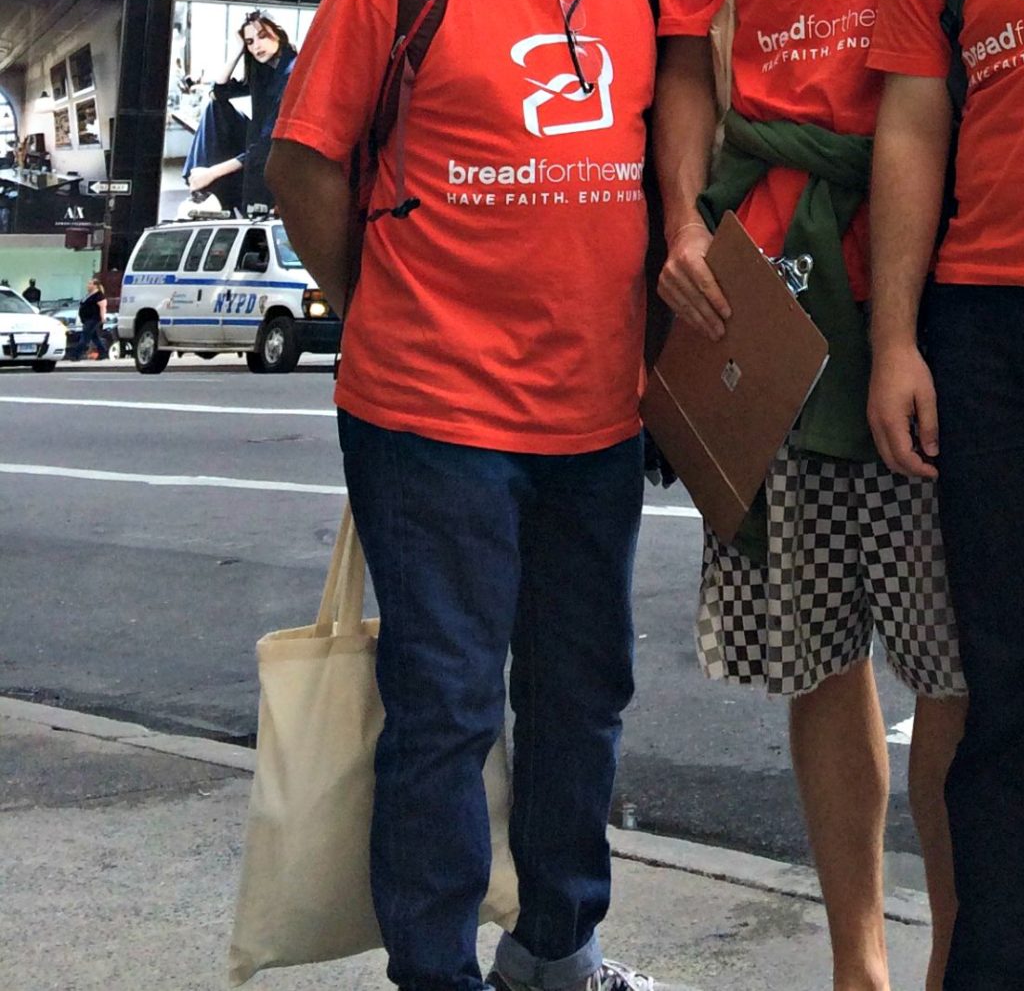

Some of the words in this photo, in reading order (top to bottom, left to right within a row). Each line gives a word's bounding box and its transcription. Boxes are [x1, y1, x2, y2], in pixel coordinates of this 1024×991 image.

[836, 36, 871, 51] END
[447, 192, 496, 206] HAVE
[578, 190, 611, 203] END
[213, 292, 257, 314] NYPD
